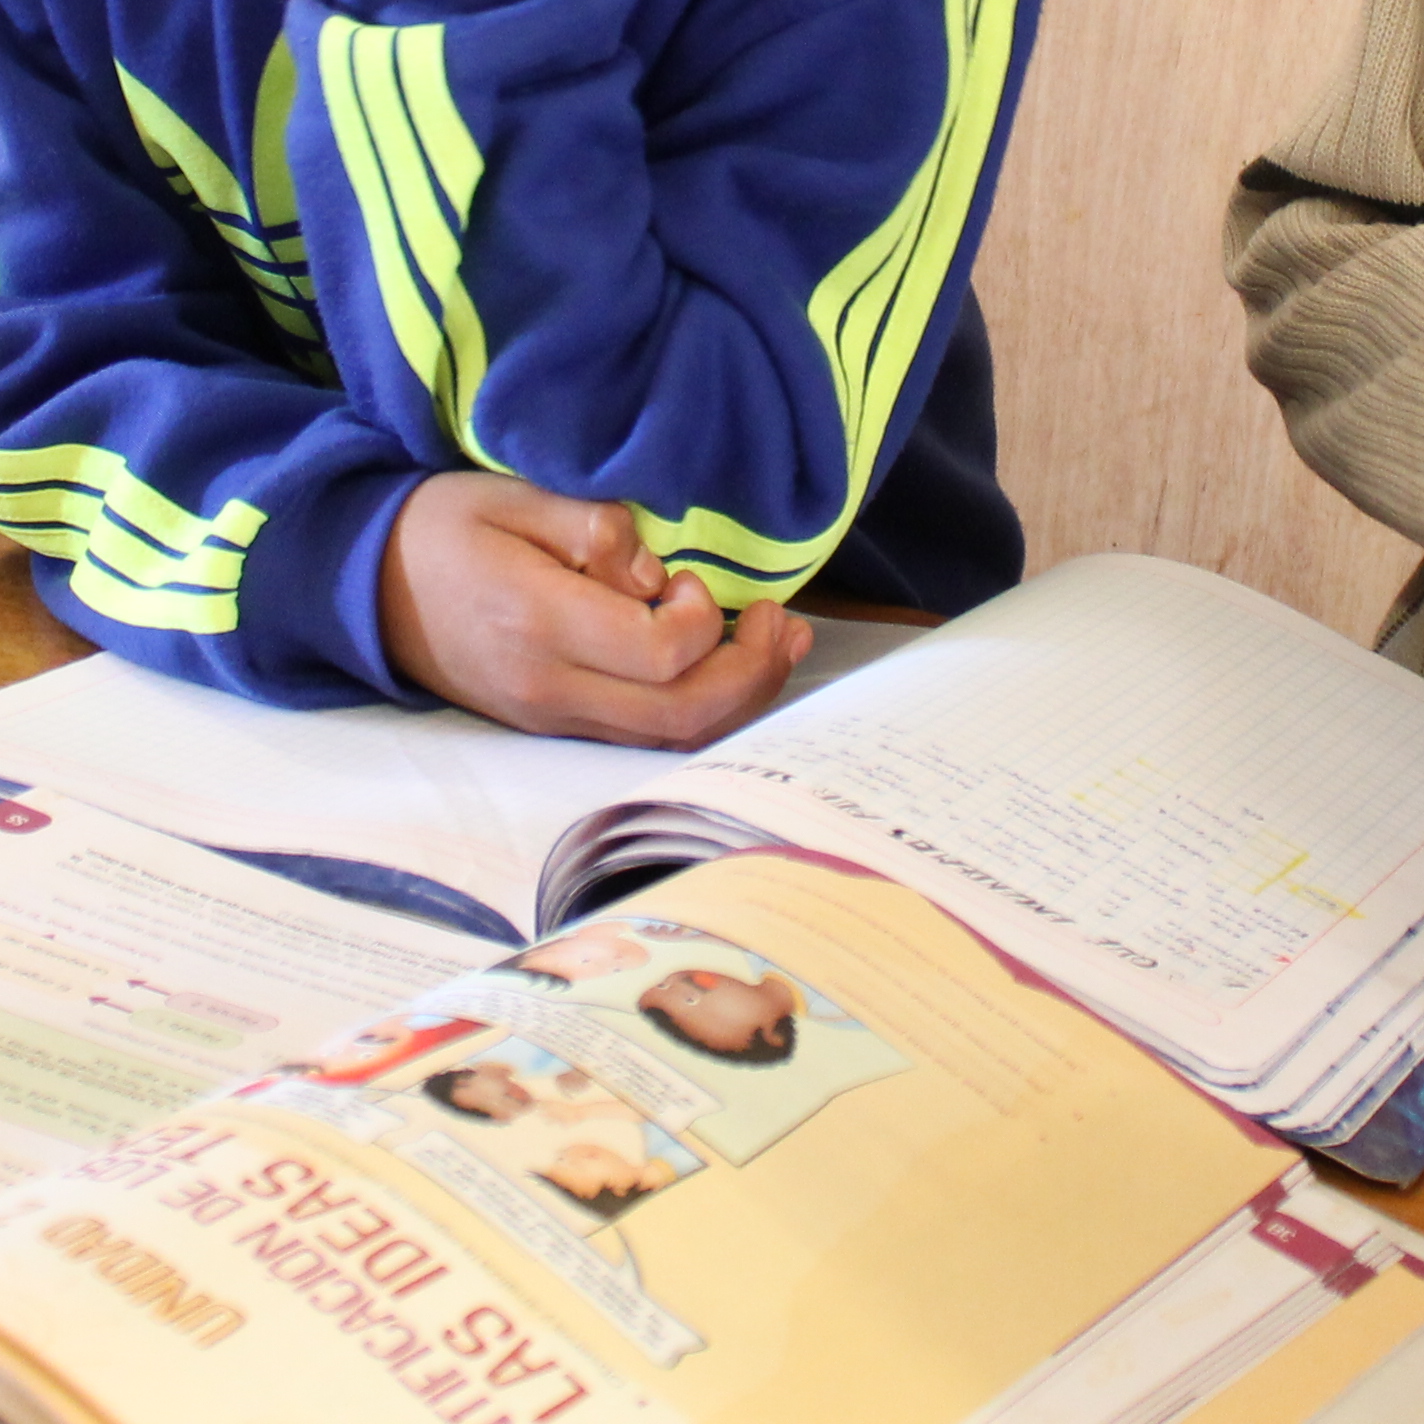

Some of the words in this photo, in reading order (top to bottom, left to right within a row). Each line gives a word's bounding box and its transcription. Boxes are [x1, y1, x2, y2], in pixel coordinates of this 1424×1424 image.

[157, 1179, 246, 1227] DE
[241, 1158, 451, 1299] IDEAS
[43, 1217, 248, 1351] UNIDAD
[233, 1221, 514, 1424] TIFICACIÓN
[442, 1306, 589, 1422] LAS
